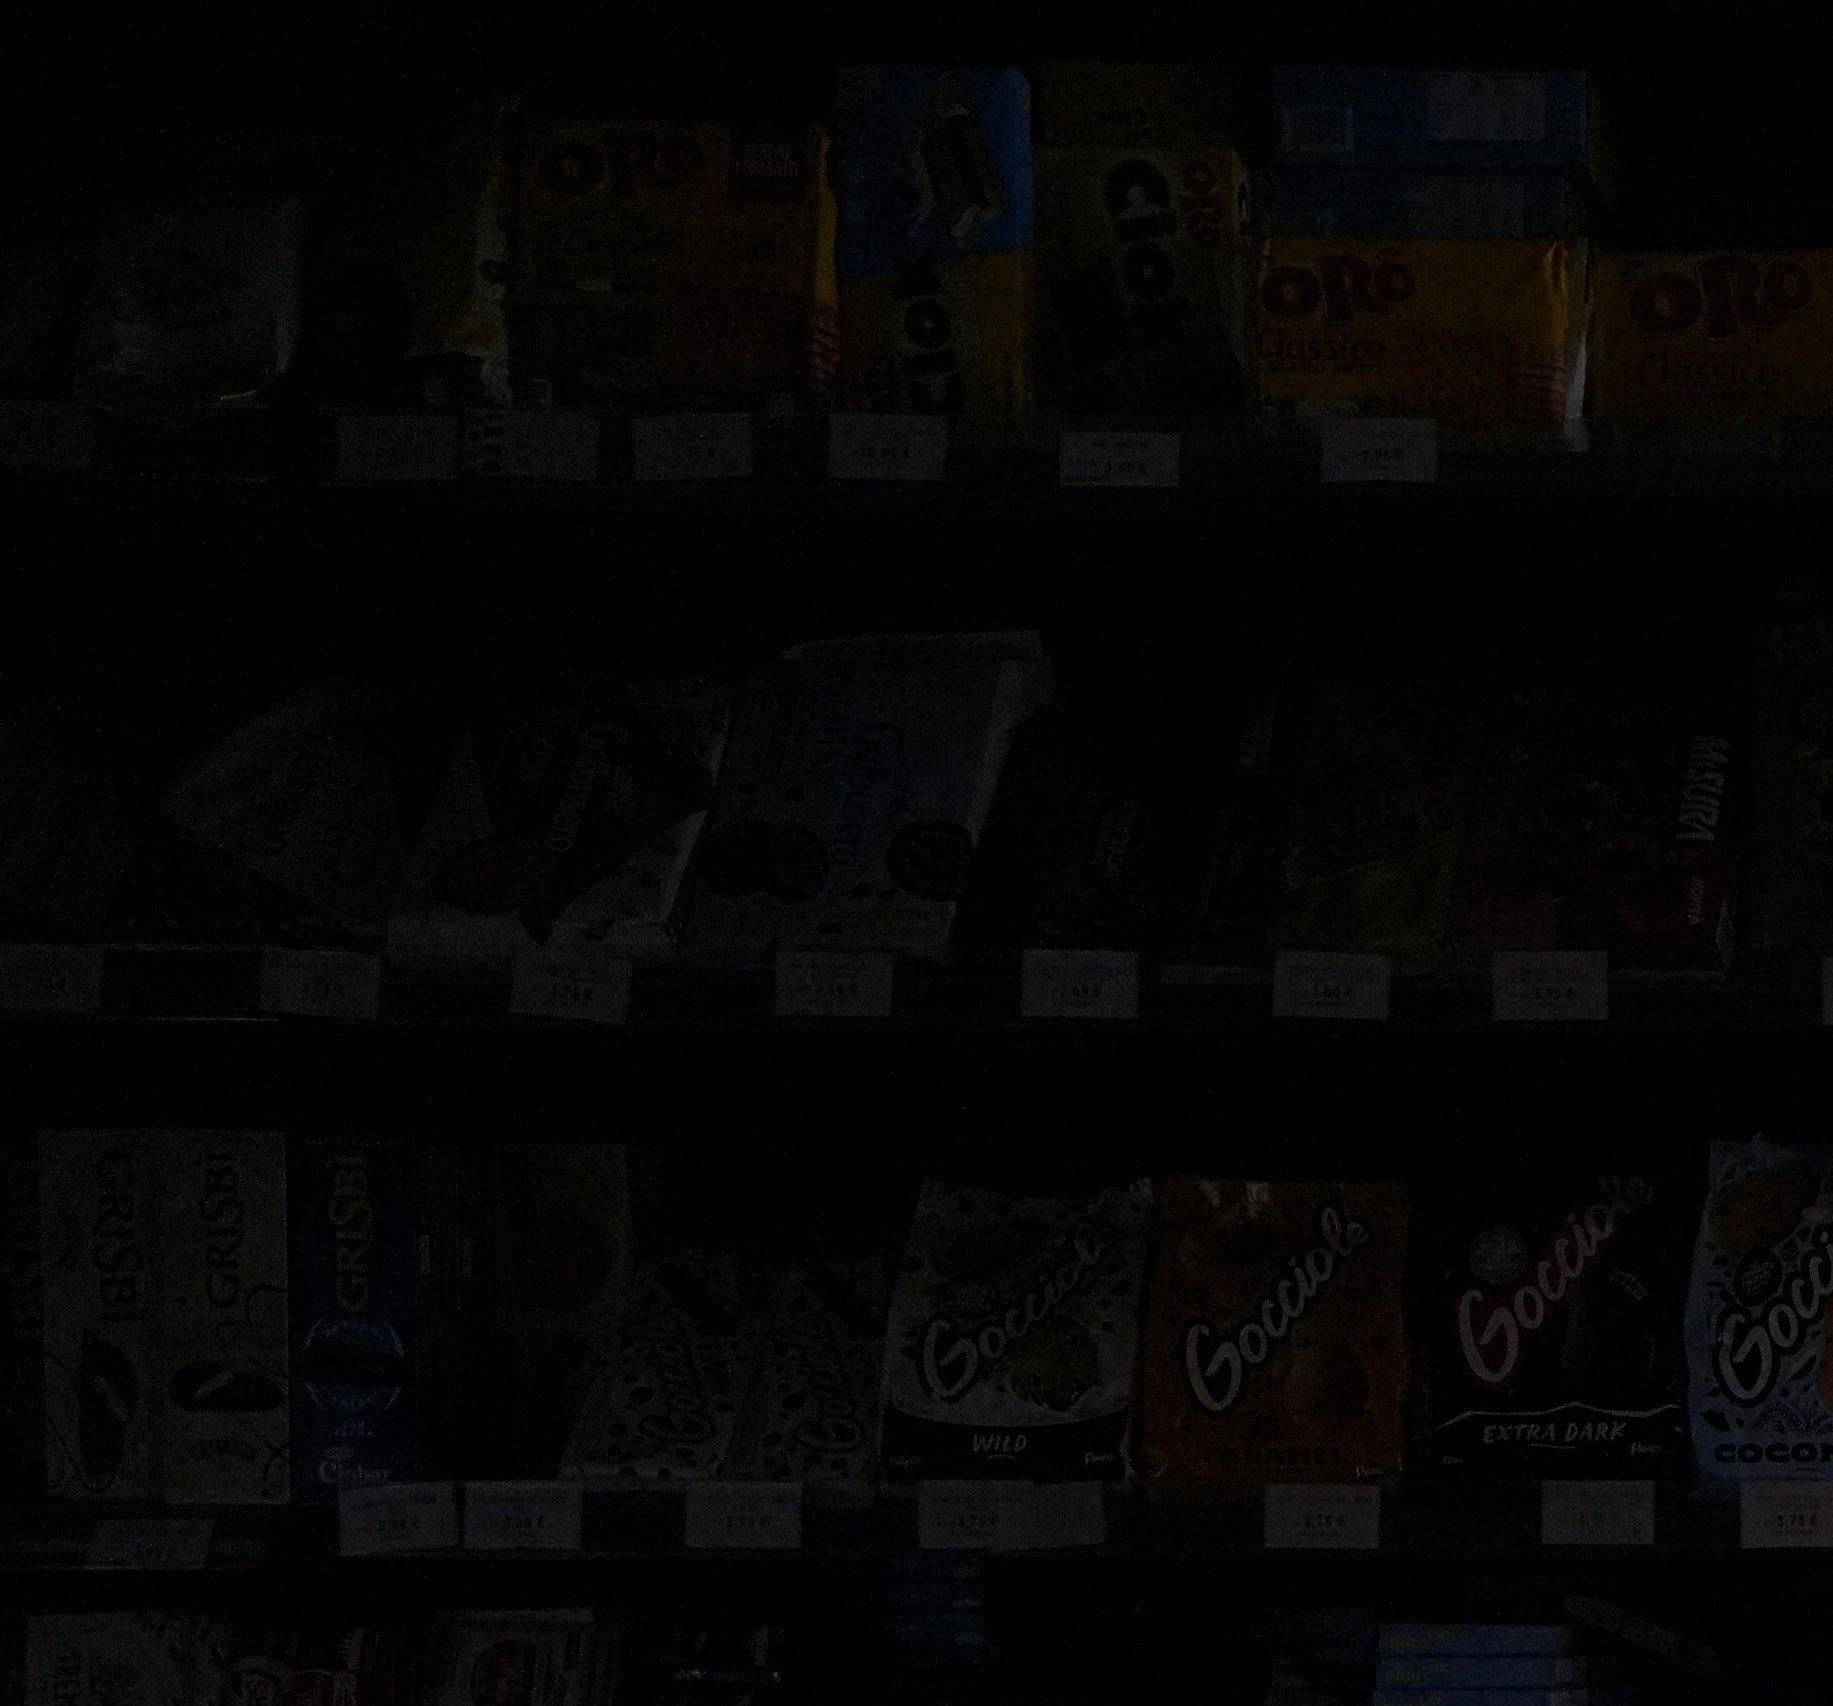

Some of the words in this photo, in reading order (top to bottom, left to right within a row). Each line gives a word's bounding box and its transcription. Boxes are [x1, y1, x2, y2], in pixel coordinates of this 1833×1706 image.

[1637, 352, 1781, 391] Classico
[1456, 1175, 1655, 1388] Gocciole
[1183, 1204, 1374, 1414] Gocciole
[972, 1433, 1028, 1454] WILD
[1482, 1421, 1556, 1444] EXTRA
[1563, 1420, 1627, 1442] DARK
